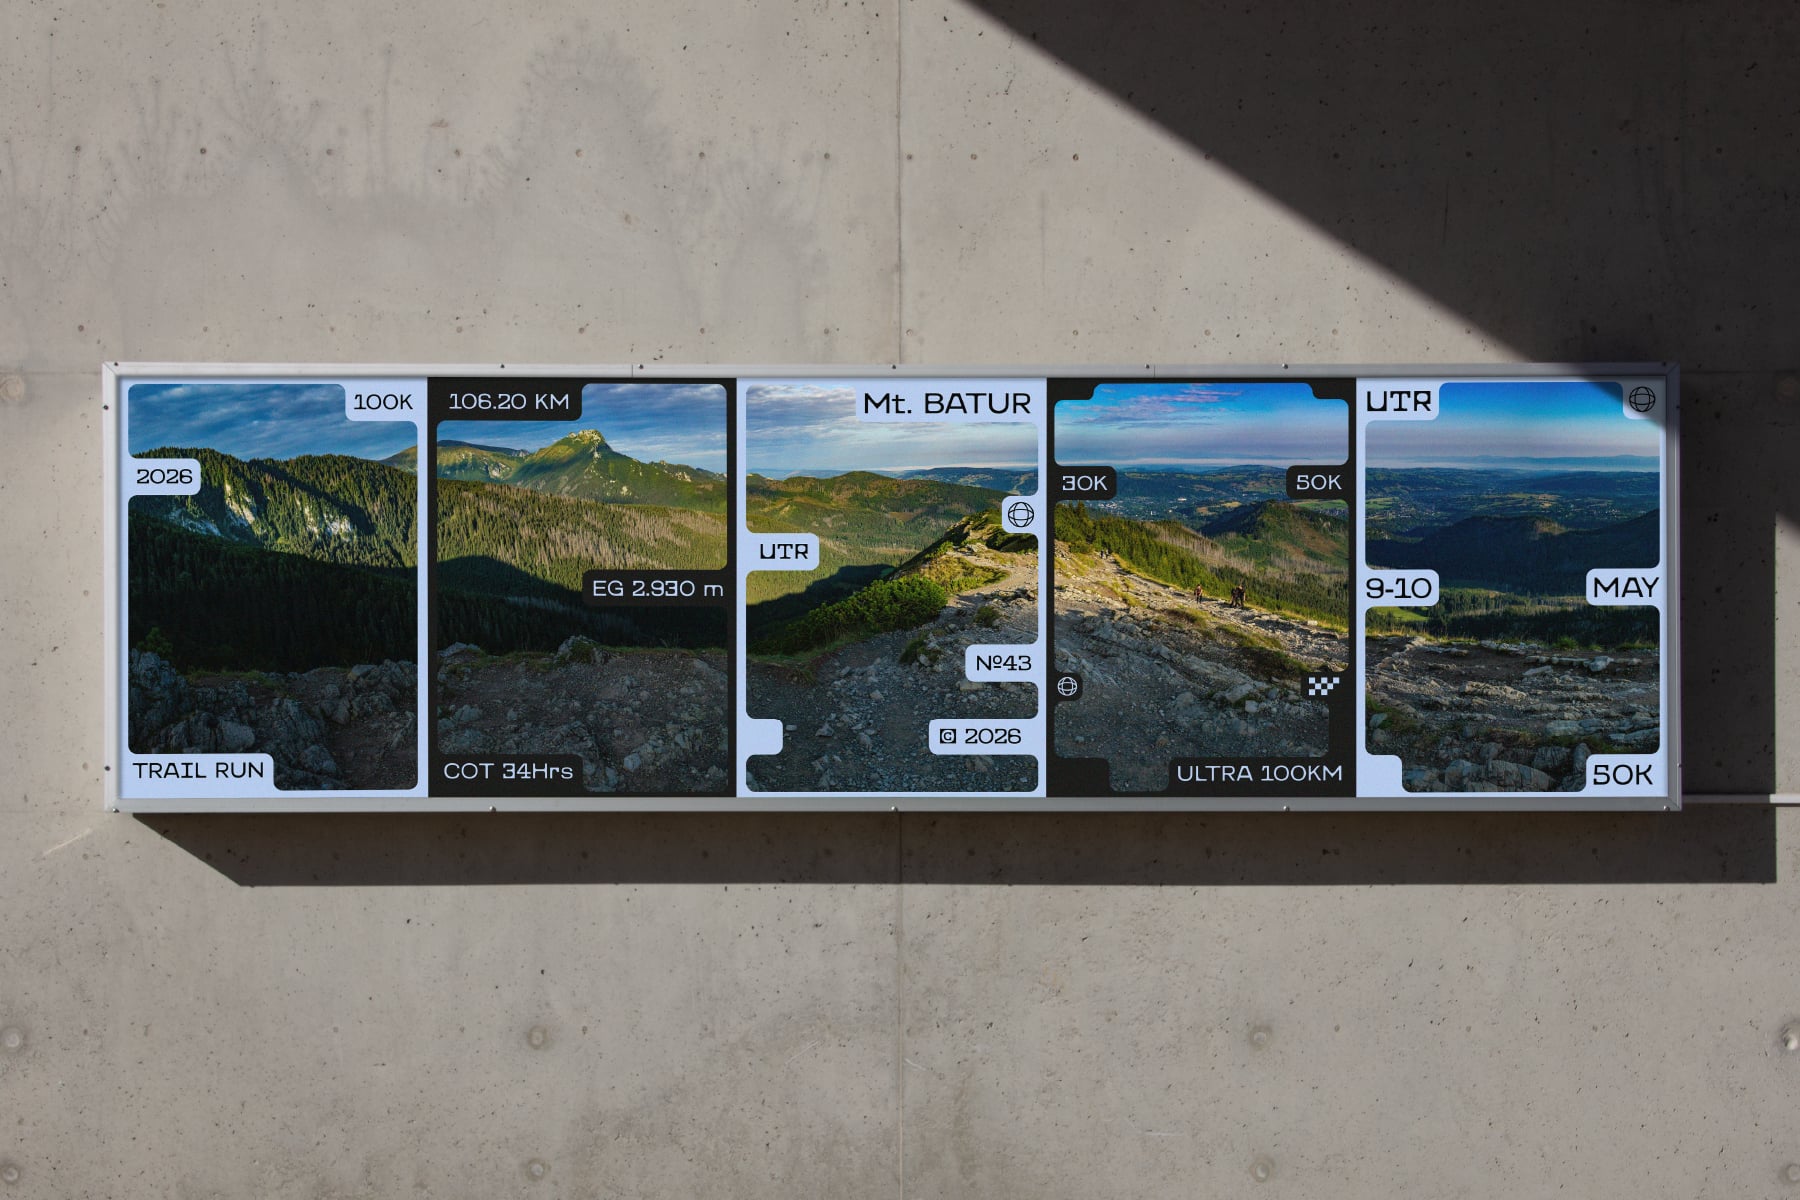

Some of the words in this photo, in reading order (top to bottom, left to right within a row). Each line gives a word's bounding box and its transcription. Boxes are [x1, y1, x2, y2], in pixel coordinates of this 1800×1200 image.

[354, 394, 414, 410] 100K
[449, 394, 527, 410] 106.20
[536, 394, 569, 410] KM
[865, 393, 912, 414] Mt.
[925, 393, 1031, 415] BATUR
[1367, 391, 1432, 412] UTR
[137, 469, 193, 485] 2026
[1063, 476, 1108, 491] 30K
[1297, 475, 1343, 491] 50K
[761, 544, 809, 560] UTR
[594, 580, 624, 597] EG
[633, 580, 696, 597] 2.930
[704, 585, 724, 597] m
[1366, 578, 1432, 599] 9-10
[1594, 577, 1660, 598] MAY
[965, 729, 1022, 745] 2026
[133, 763, 207, 779] TRAIL
[216, 762, 264, 779] RUN
[444, 763, 495, 780] COT
[503, 763, 574, 780] 34Hrs
[1178, 766, 1254, 782] ULTRA
[1261, 765, 1342, 782] 100KM
[1594, 765, 1653, 786] 50K
